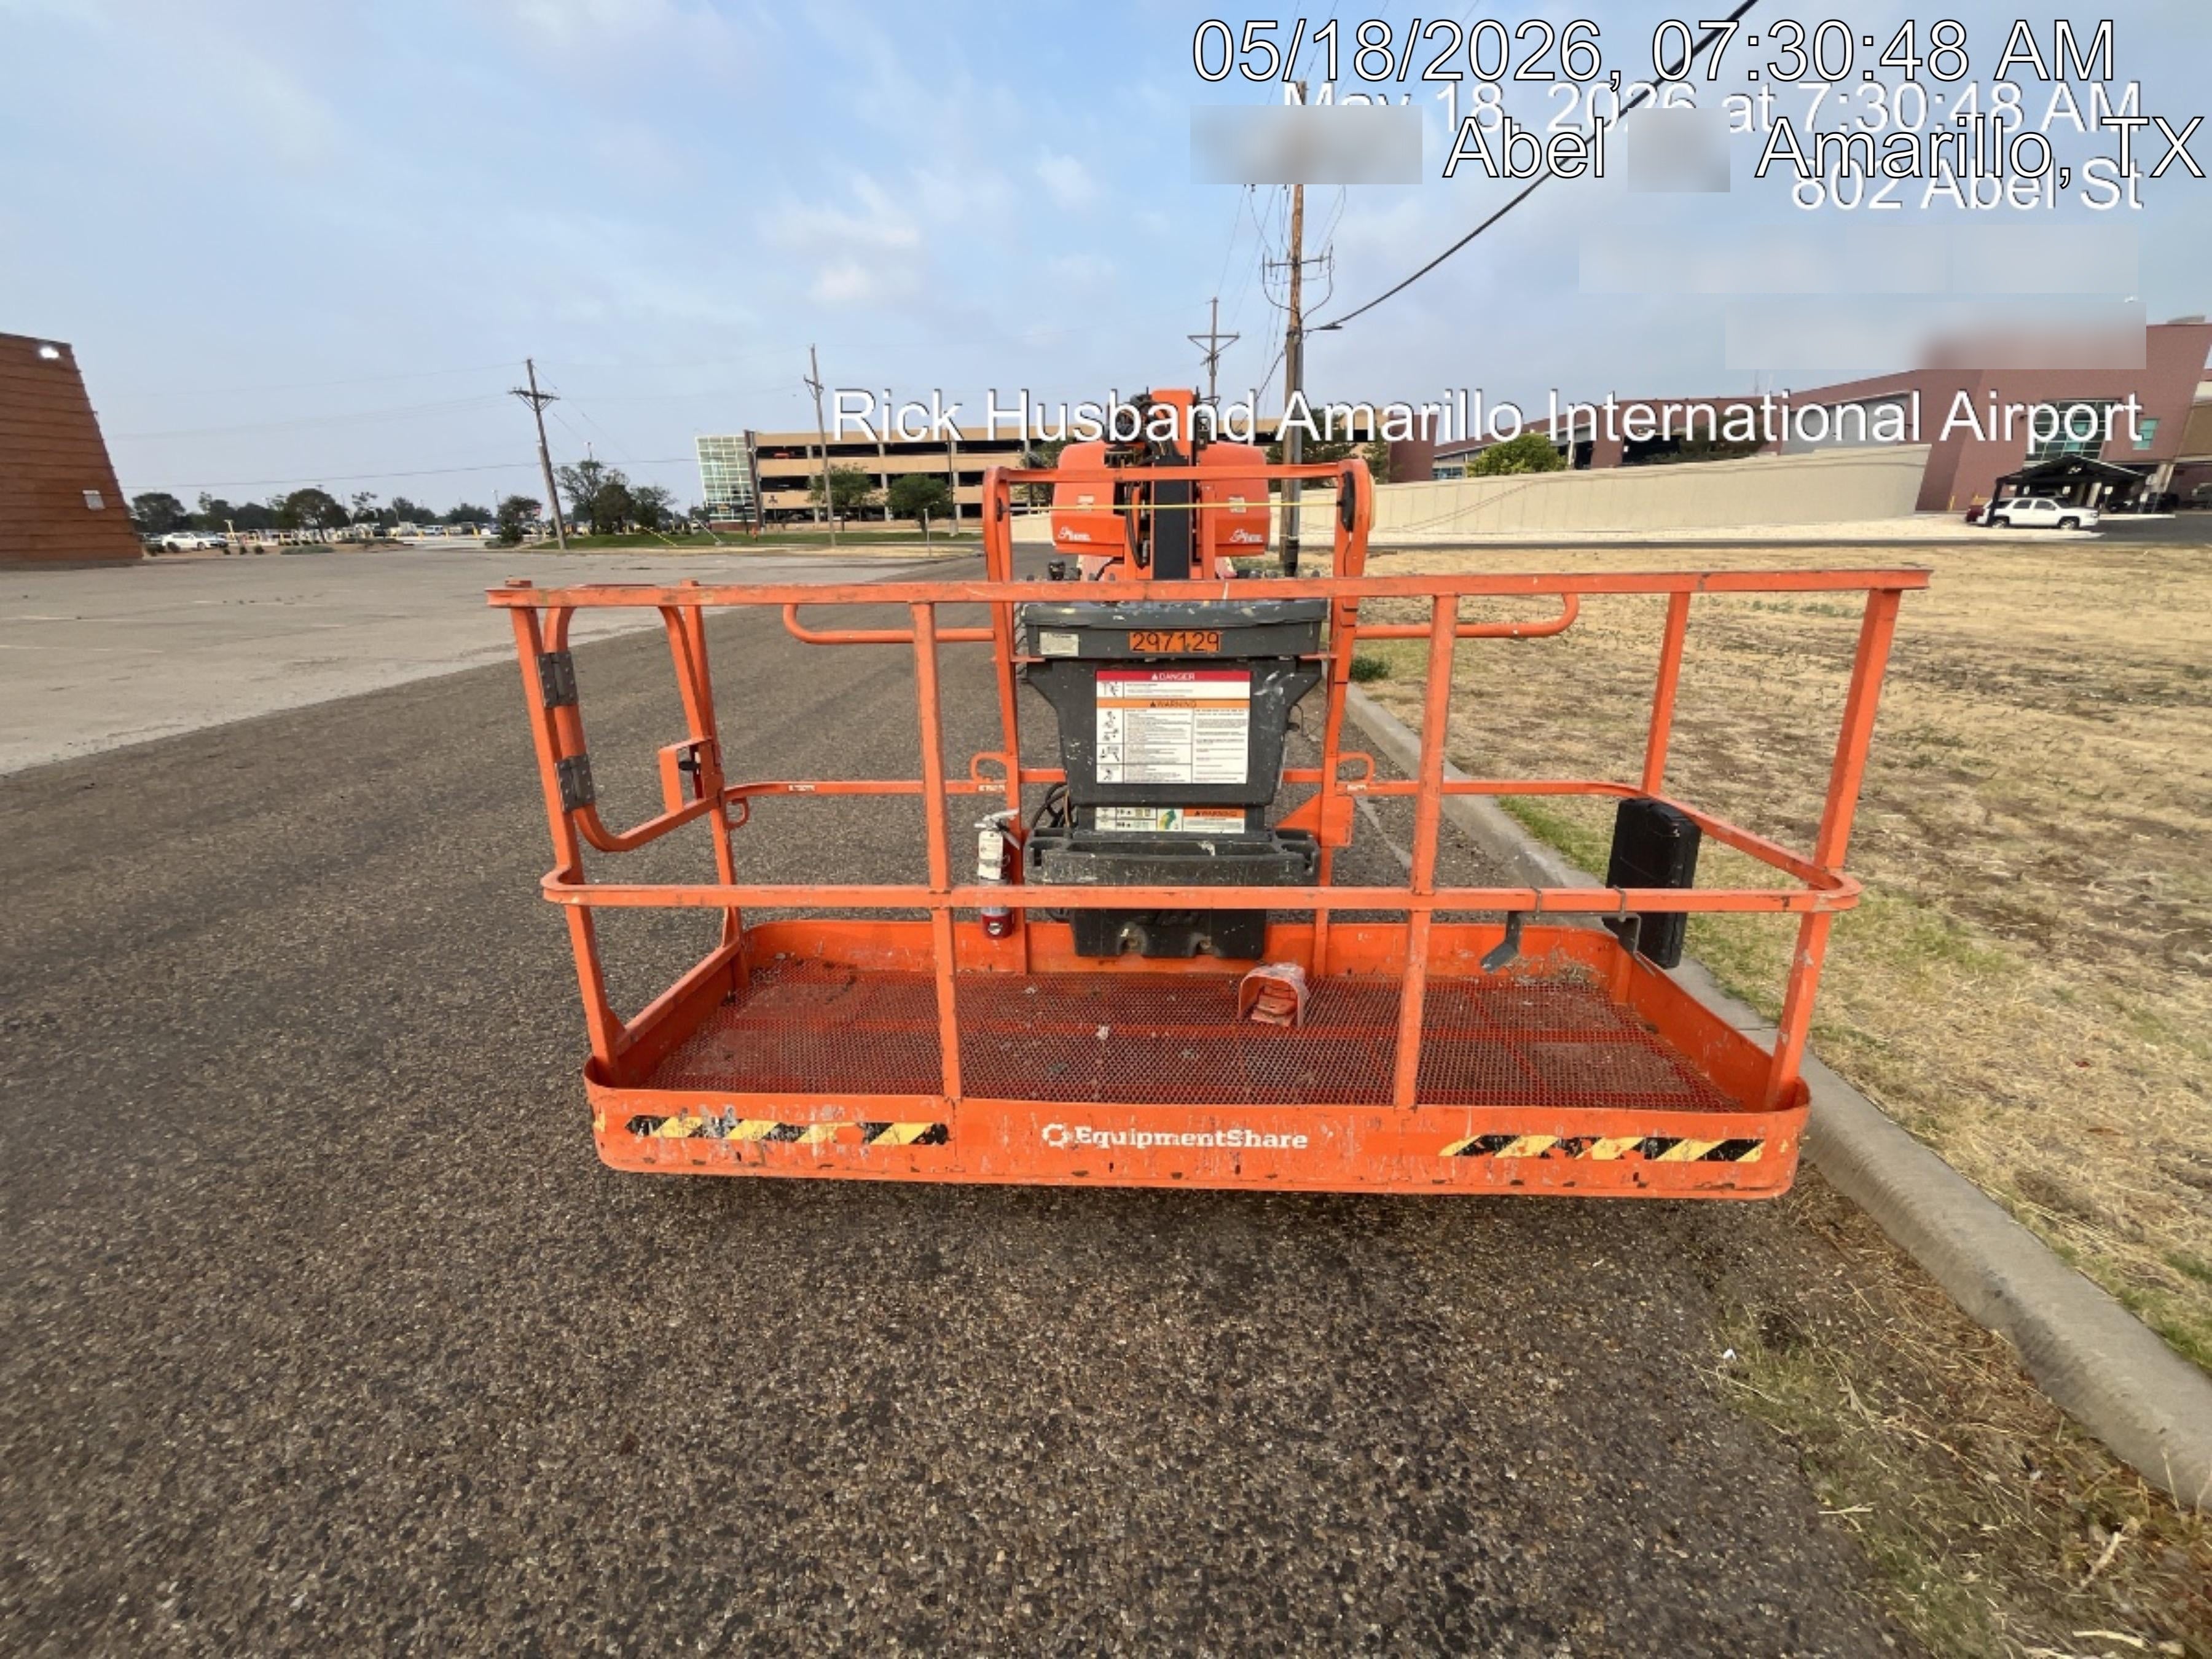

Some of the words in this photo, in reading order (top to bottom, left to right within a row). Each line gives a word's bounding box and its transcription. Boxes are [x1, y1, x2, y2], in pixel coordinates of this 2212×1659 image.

[1132, 630, 1220, 651] 297129
[1158, 672, 1195, 681] DANGER
[1073, 1125, 1309, 1150] EquipmentShare
